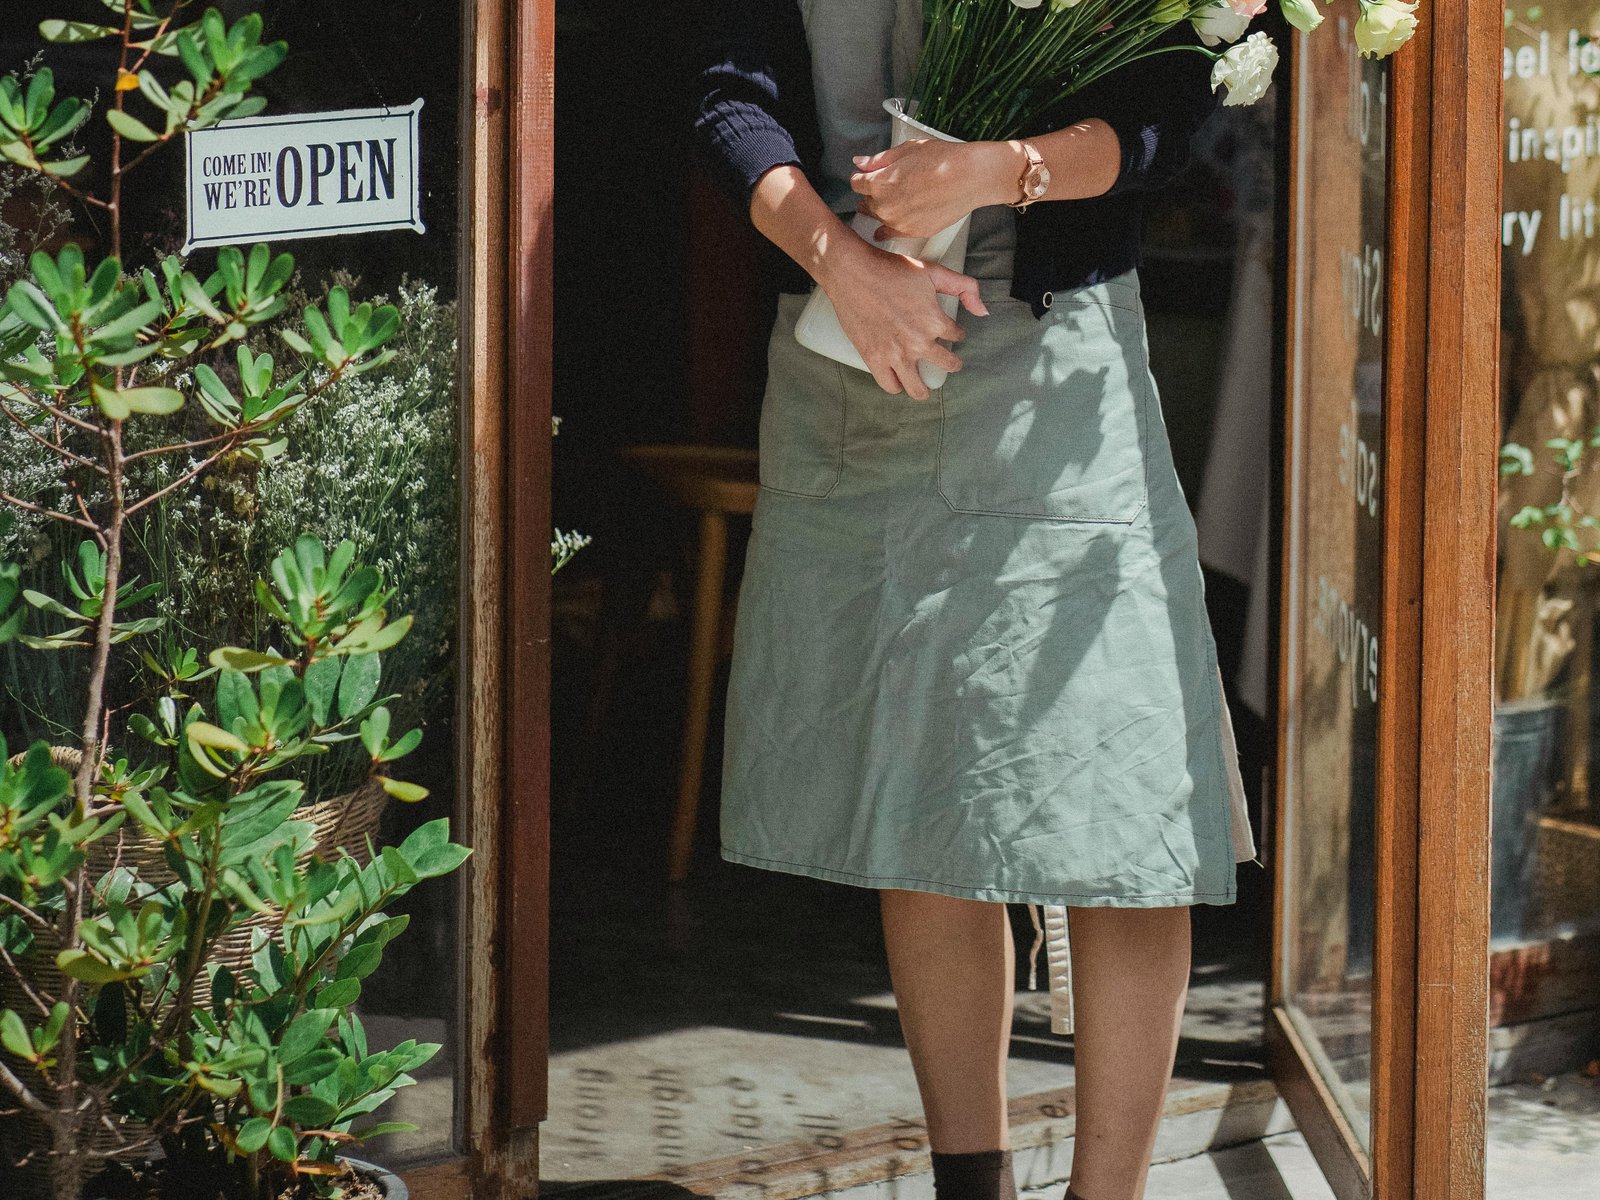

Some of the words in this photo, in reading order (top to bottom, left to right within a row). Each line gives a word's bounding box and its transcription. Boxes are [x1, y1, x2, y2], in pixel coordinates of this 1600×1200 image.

[203, 153, 247, 177] COME
[250, 151, 272, 174] IN!
[1508, 117, 1600, 174] inspi
[203, 178, 271, 211] WE'RE
[275, 138, 398, 208] OPEN
